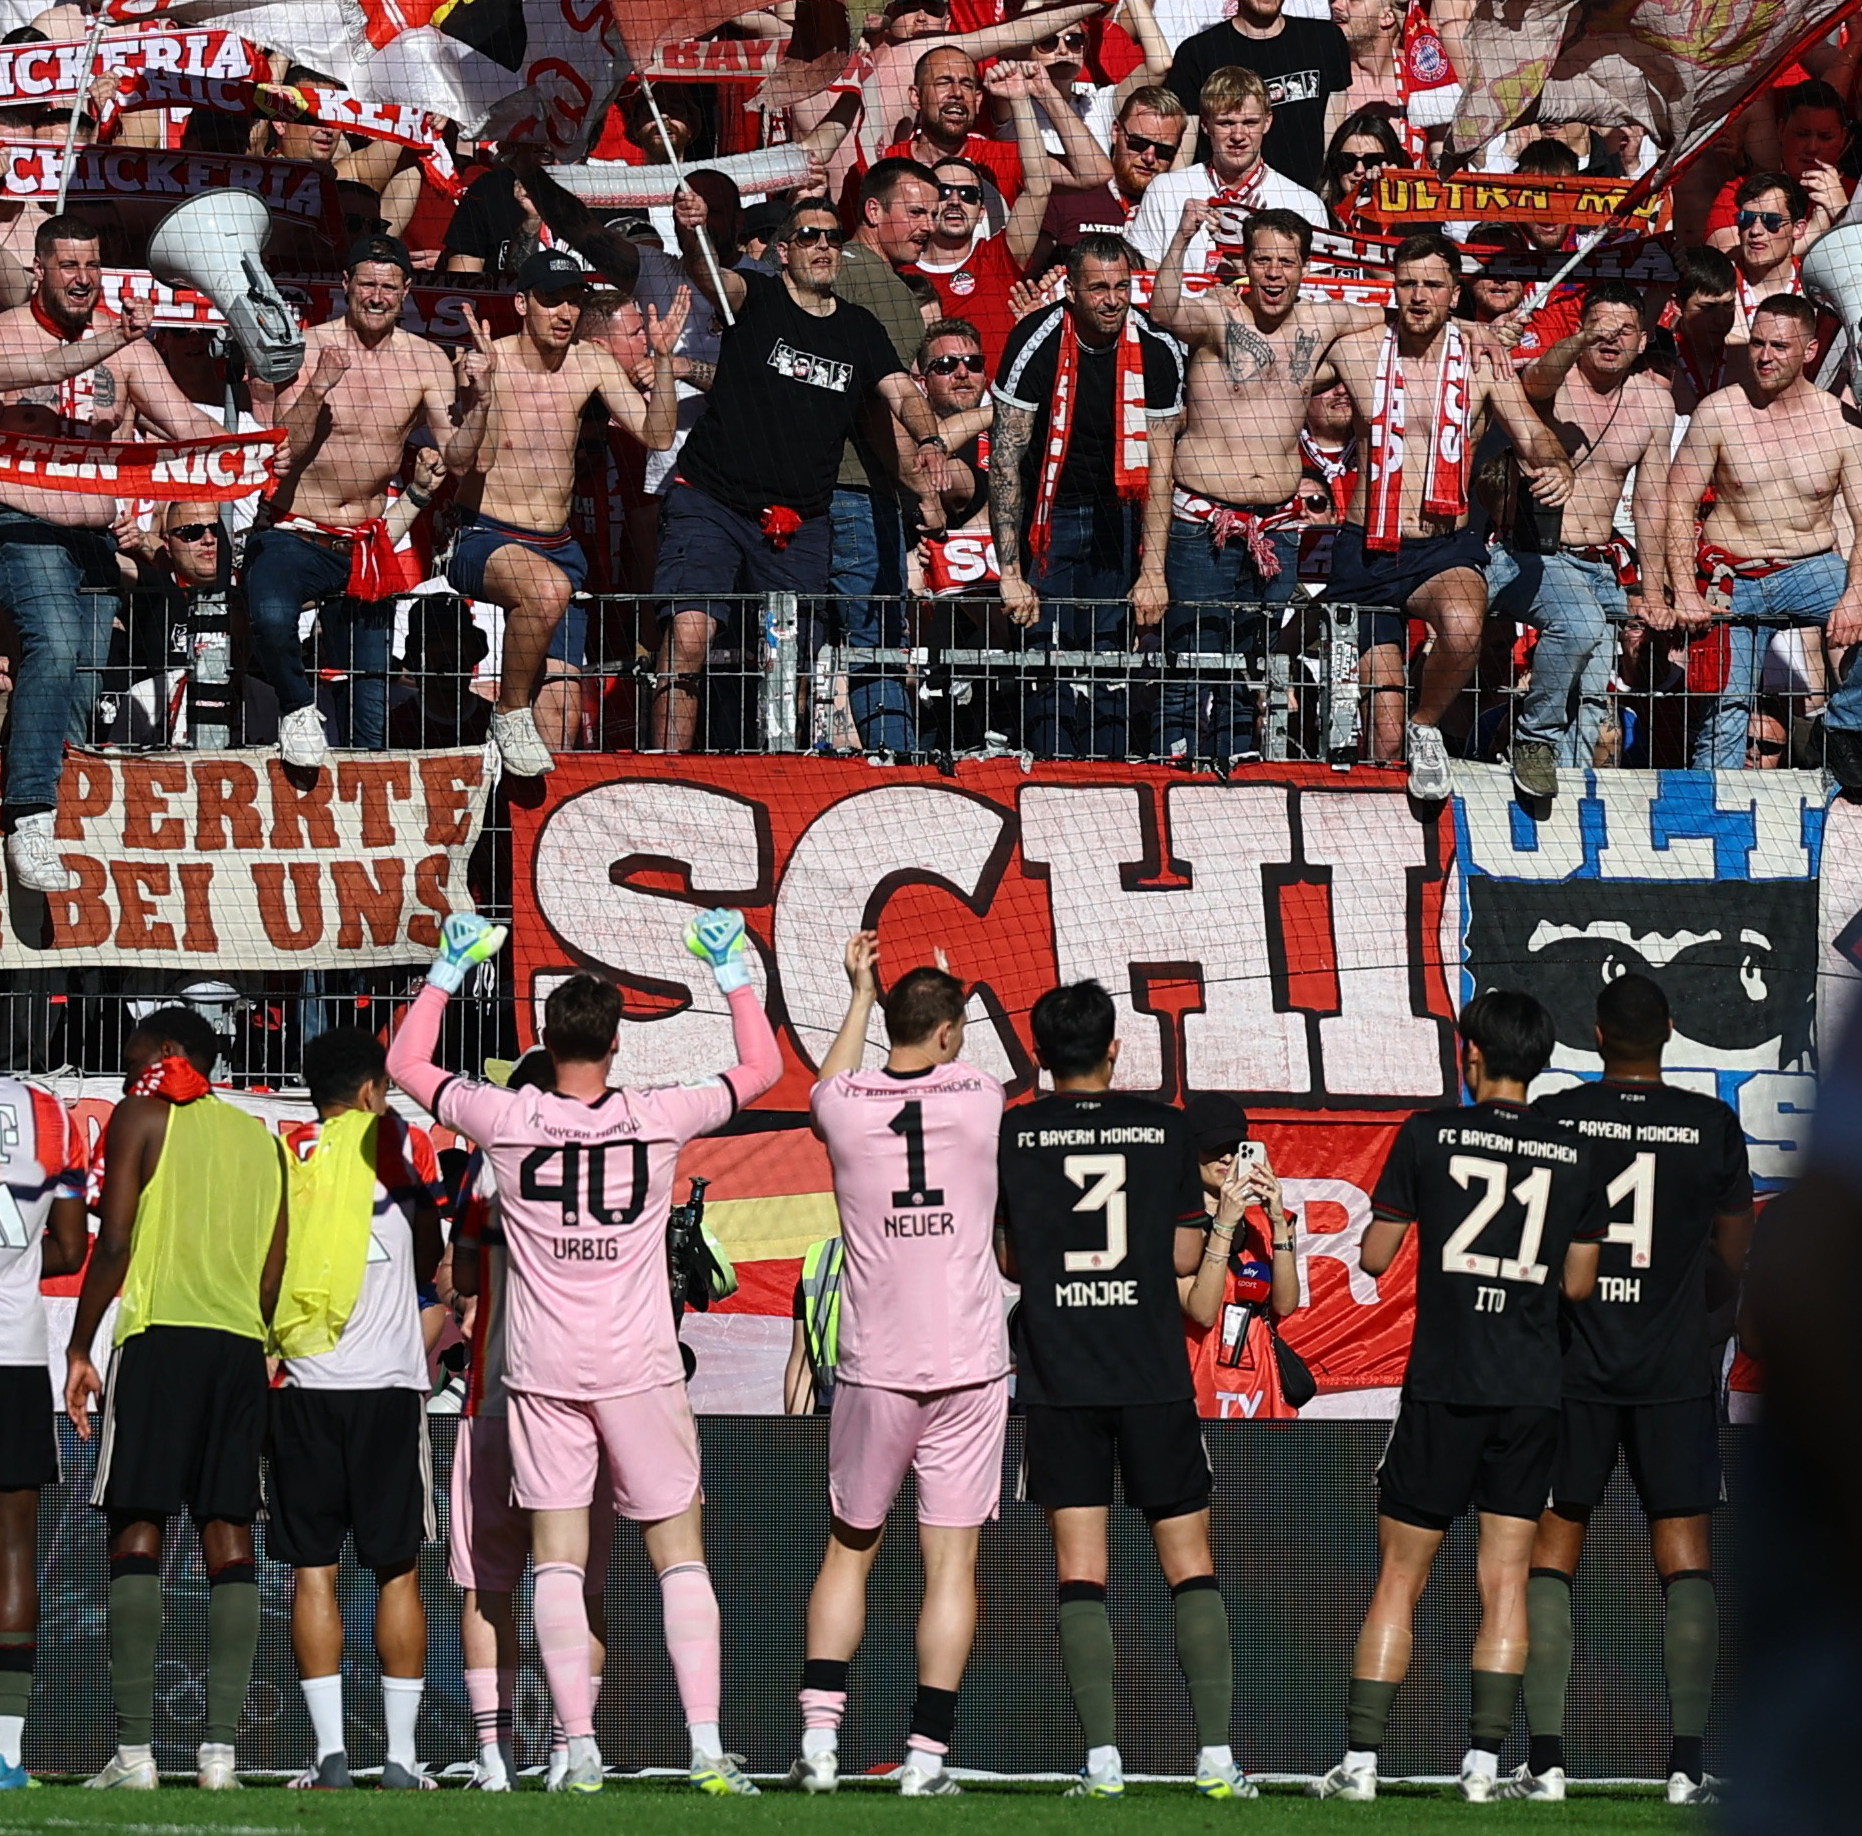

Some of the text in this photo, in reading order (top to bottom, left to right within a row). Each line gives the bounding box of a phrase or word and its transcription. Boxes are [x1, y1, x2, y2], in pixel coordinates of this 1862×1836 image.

[4, 143, 325, 218] CHICKERIA
[1079, 222, 1125, 236] BAYERN
[46, 852, 218, 953] BEI
[251, 852, 455, 953] UNS
[1017, 1125, 1165, 1148] FC BAYERN MÜNCHEN
[1437, 1127, 1578, 1163] FC BAYERN MÜNCHEN
[1578, 1120, 1700, 1145] BAYERN MÜNCHEN
[886, 1099, 947, 1210] 1
[520, 1140, 650, 1226] 40
[883, 1212, 956, 1240] NEUER
[1062, 1152, 1130, 1273] 3
[1441, 1153, 1553, 1285] 21
[552, 1237, 619, 1261] URBIG
[1241, 1266, 1260, 1278] sky
[1054, 1278, 1139, 1309] MINJAE
[1474, 1285, 1506, 1314] ITO
[1596, 1277, 1642, 1304] TAH
